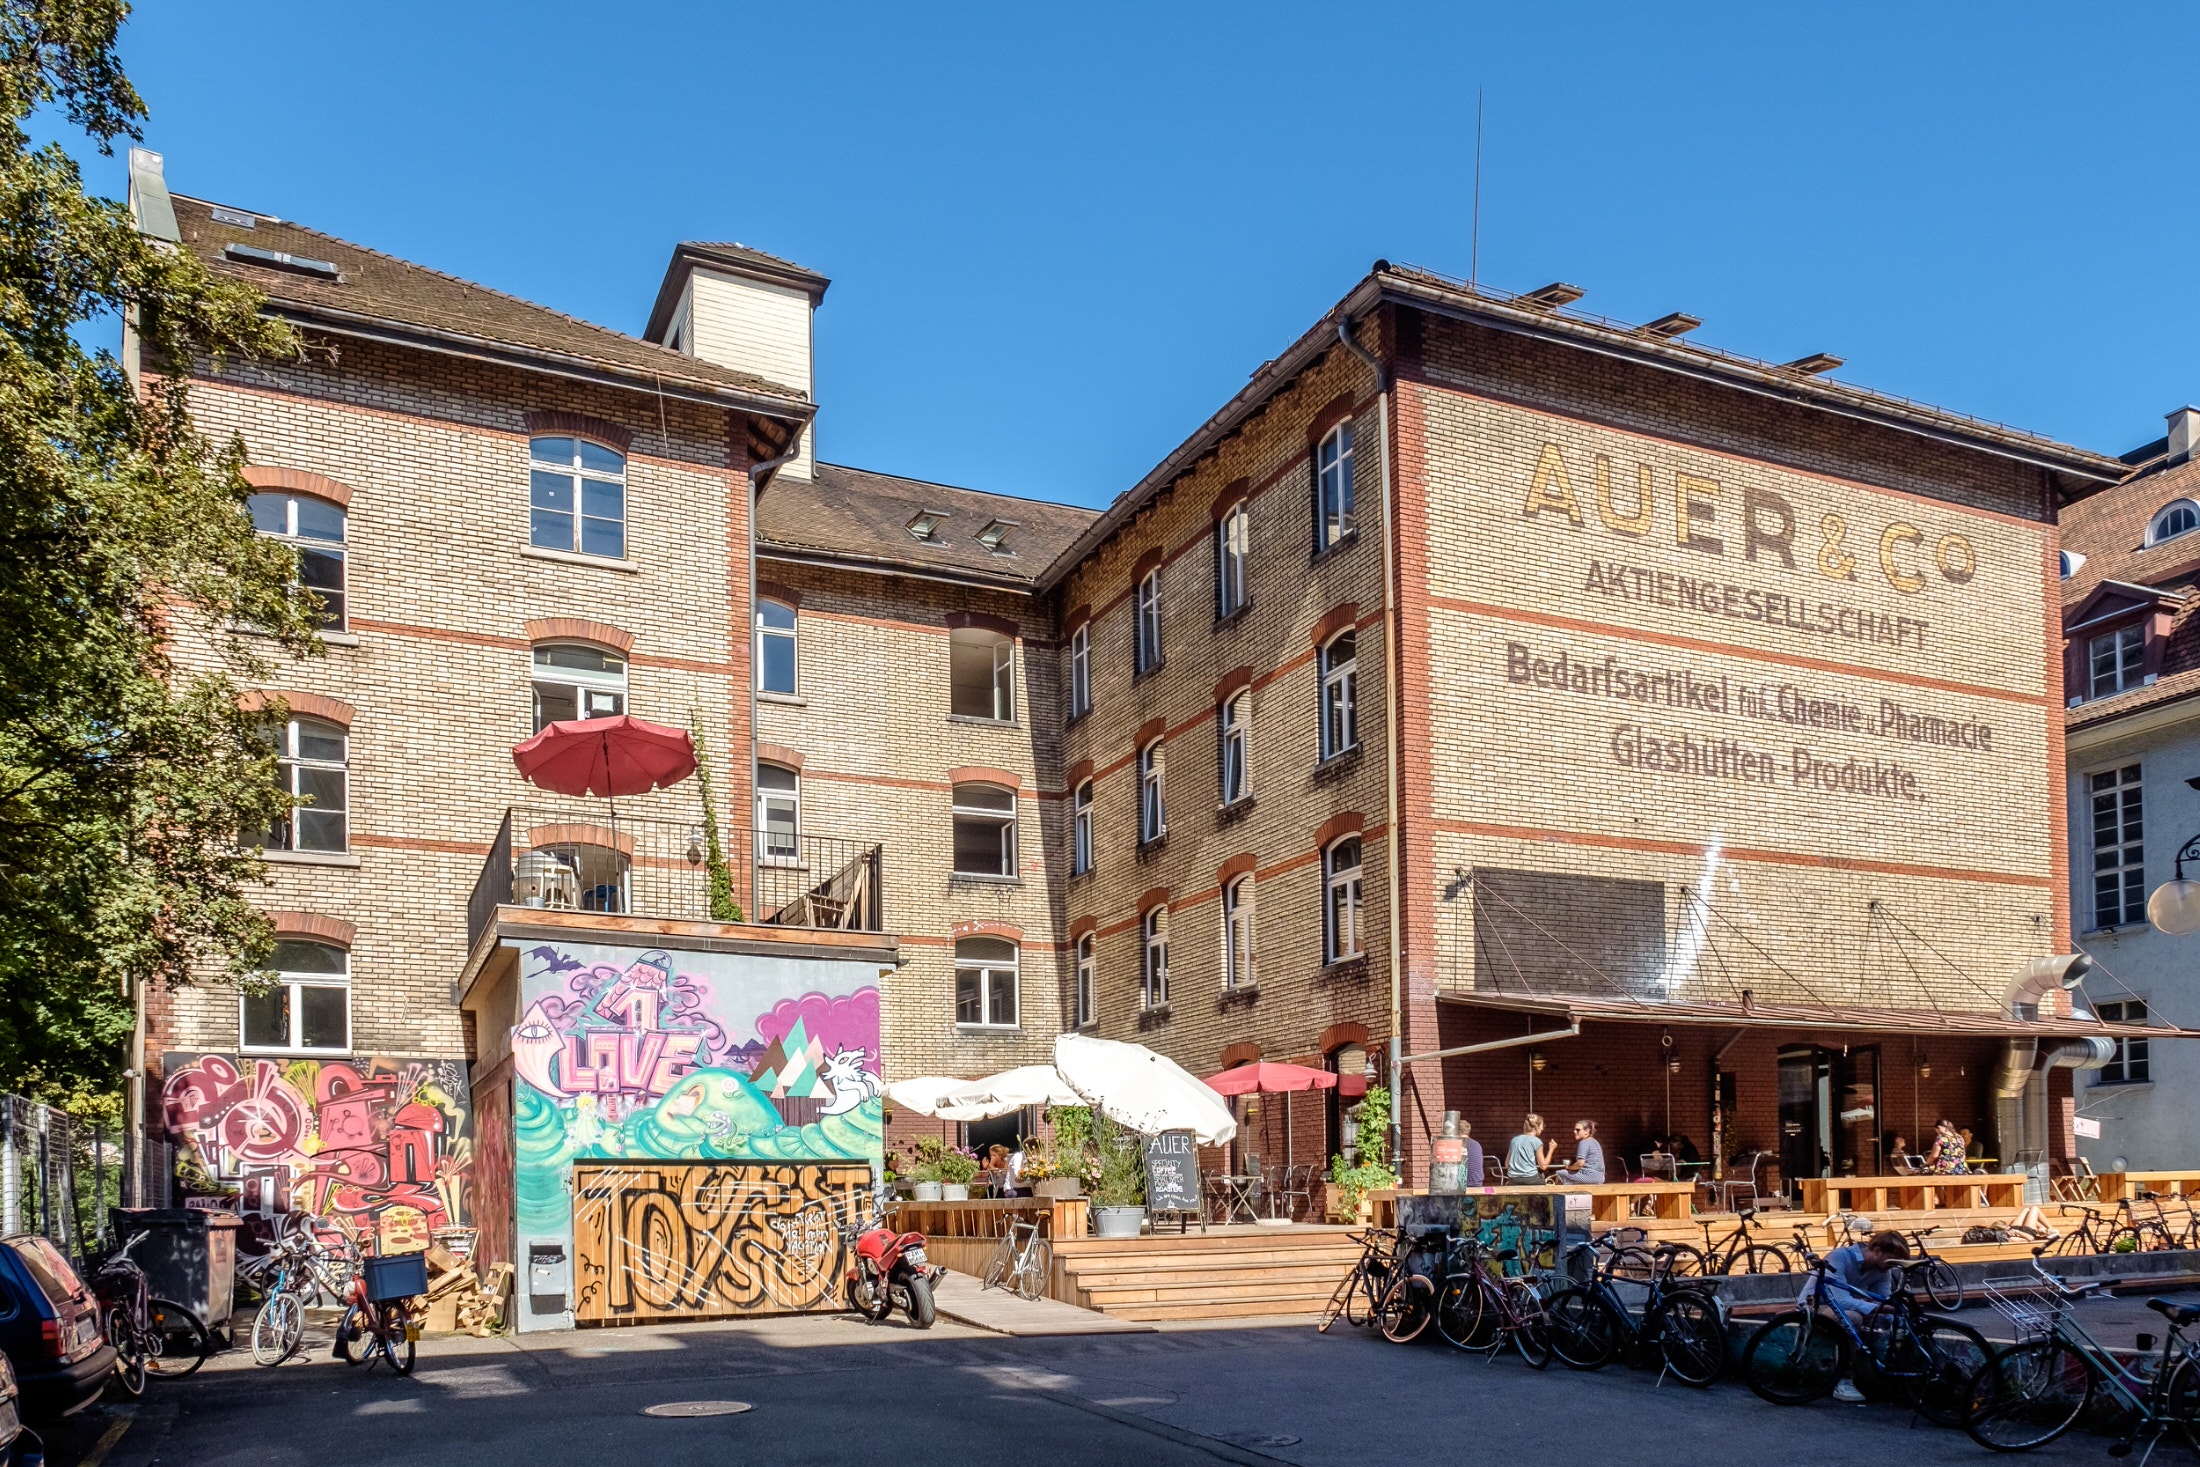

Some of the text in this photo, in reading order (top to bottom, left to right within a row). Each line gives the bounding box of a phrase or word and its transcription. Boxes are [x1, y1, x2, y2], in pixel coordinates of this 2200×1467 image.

[1523, 442, 1797, 569] AUER
[1584, 560, 1929, 650] AKTIENGESELLSCHAFT
[1507, 641, 1727, 713] Bedarfsartikel
[1777, 683, 1862, 732] Chemie
[1880, 698, 1992, 750] Pharmacie
[1149, 1136, 1190, 1154] AUER
